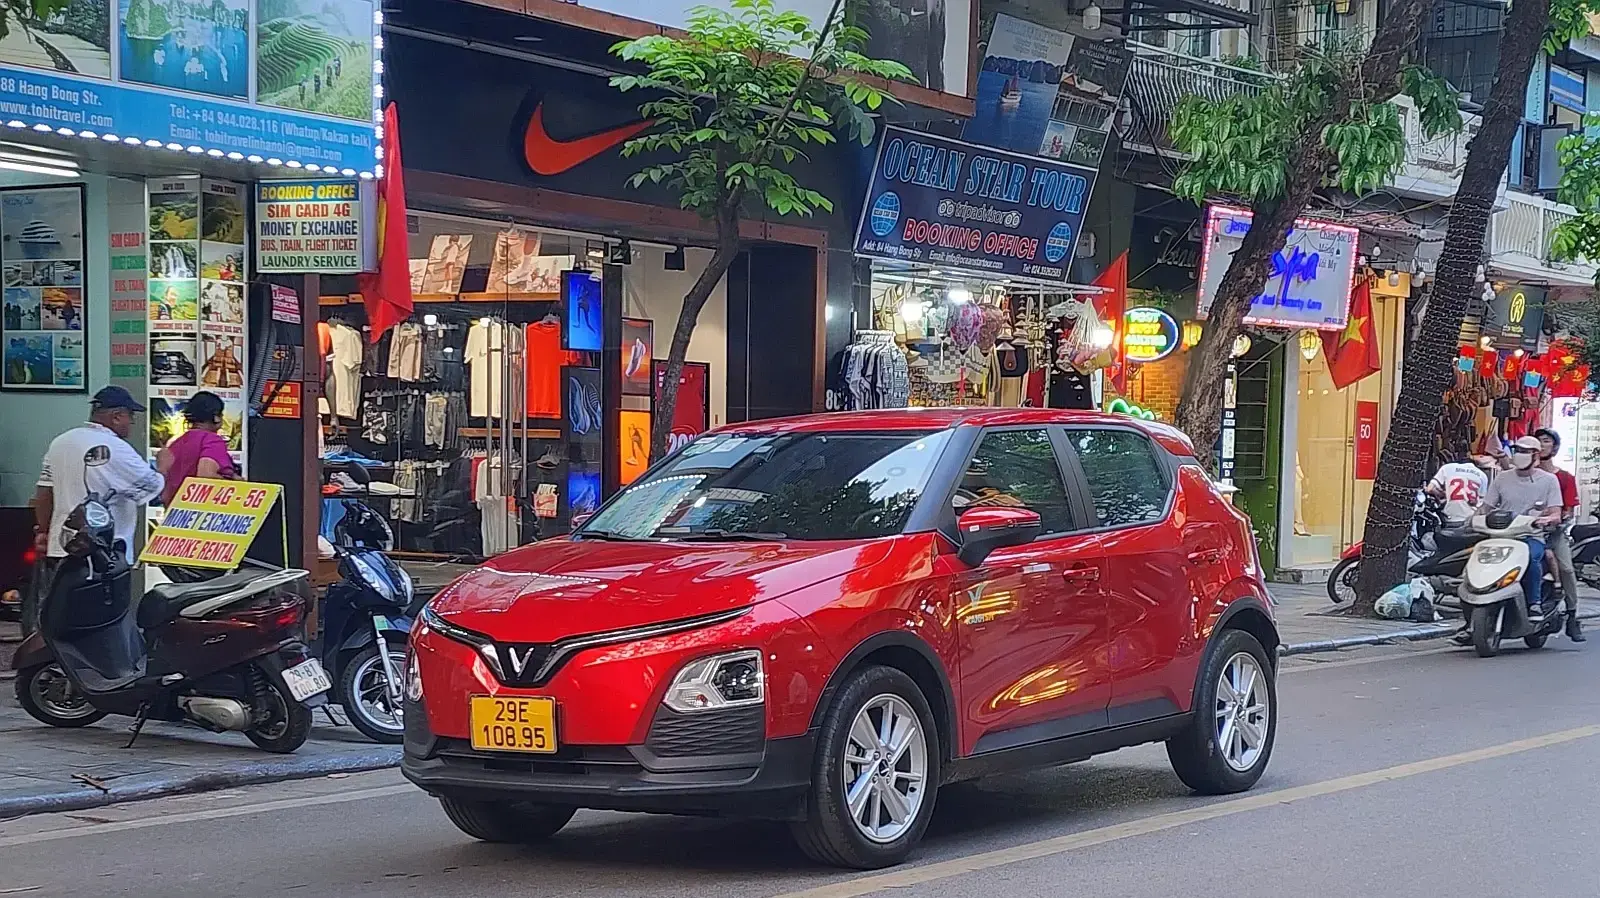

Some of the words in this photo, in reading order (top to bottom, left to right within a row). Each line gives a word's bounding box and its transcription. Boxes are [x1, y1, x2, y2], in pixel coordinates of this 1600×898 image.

[0, 77, 15, 92] 88
[19, 80, 48, 100] Hang
[52, 85, 79, 105] Bong
[82, 90, 102, 106] Str.
[0, 101, 113, 127] www.tobitravel.com
[170, 104, 190, 120] Tel:
[193, 109, 214, 123] +84
[217, 111, 278, 133] 944.028.116
[351, 132, 371, 150] talk)
[170, 124, 202, 140] Email:
[205, 129, 342, 161] tobitravelinhanoi@gmail.com
[883, 138, 966, 192] OCEAN
[964, 155, 1027, 203] STAR
[1027, 167, 1087, 214] TOUR
[261, 185, 315, 200] BOOKING
[316, 184, 356, 199] OFFICE
[267, 204, 291, 218] SIM
[295, 204, 329, 218] CARD
[333, 203, 351, 217] 4G
[260, 221, 298, 236] MONEY
[301, 220, 358, 235] EXCHANGE
[903, 218, 982, 252] BOOKING
[983, 231, 1039, 260] OFFICE
[260, 239, 278, 252] BUS,
[280, 239, 304, 252] TRAIN,
[305, 239, 330, 252] FLIGHT
[331, 238, 358, 251] TICKET
[876, 243, 884, 253] 84
[884, 244, 898, 256] Hang
[262, 255, 312, 268] LAUNDRY
[313, 255, 357, 267] SERVICE
[1022, 263, 1031, 274] Tel:
[1360, 424, 1371, 440] 50
[182, 483, 214, 504] SIM
[212, 486, 236, 506] 4G
[243, 489, 267, 509] 5G
[1450, 477, 1480, 506] 25
[162, 508, 200, 530] MONEY
[200, 512, 255, 535] EXCHANGE
[146, 535, 202, 559] MOTOBIKE
[200, 540, 239, 563] RENTAL
[294, 675, 328, 698] 100.80
[494, 700, 529, 723] 29E
[483, 724, 546, 749] 108.95
